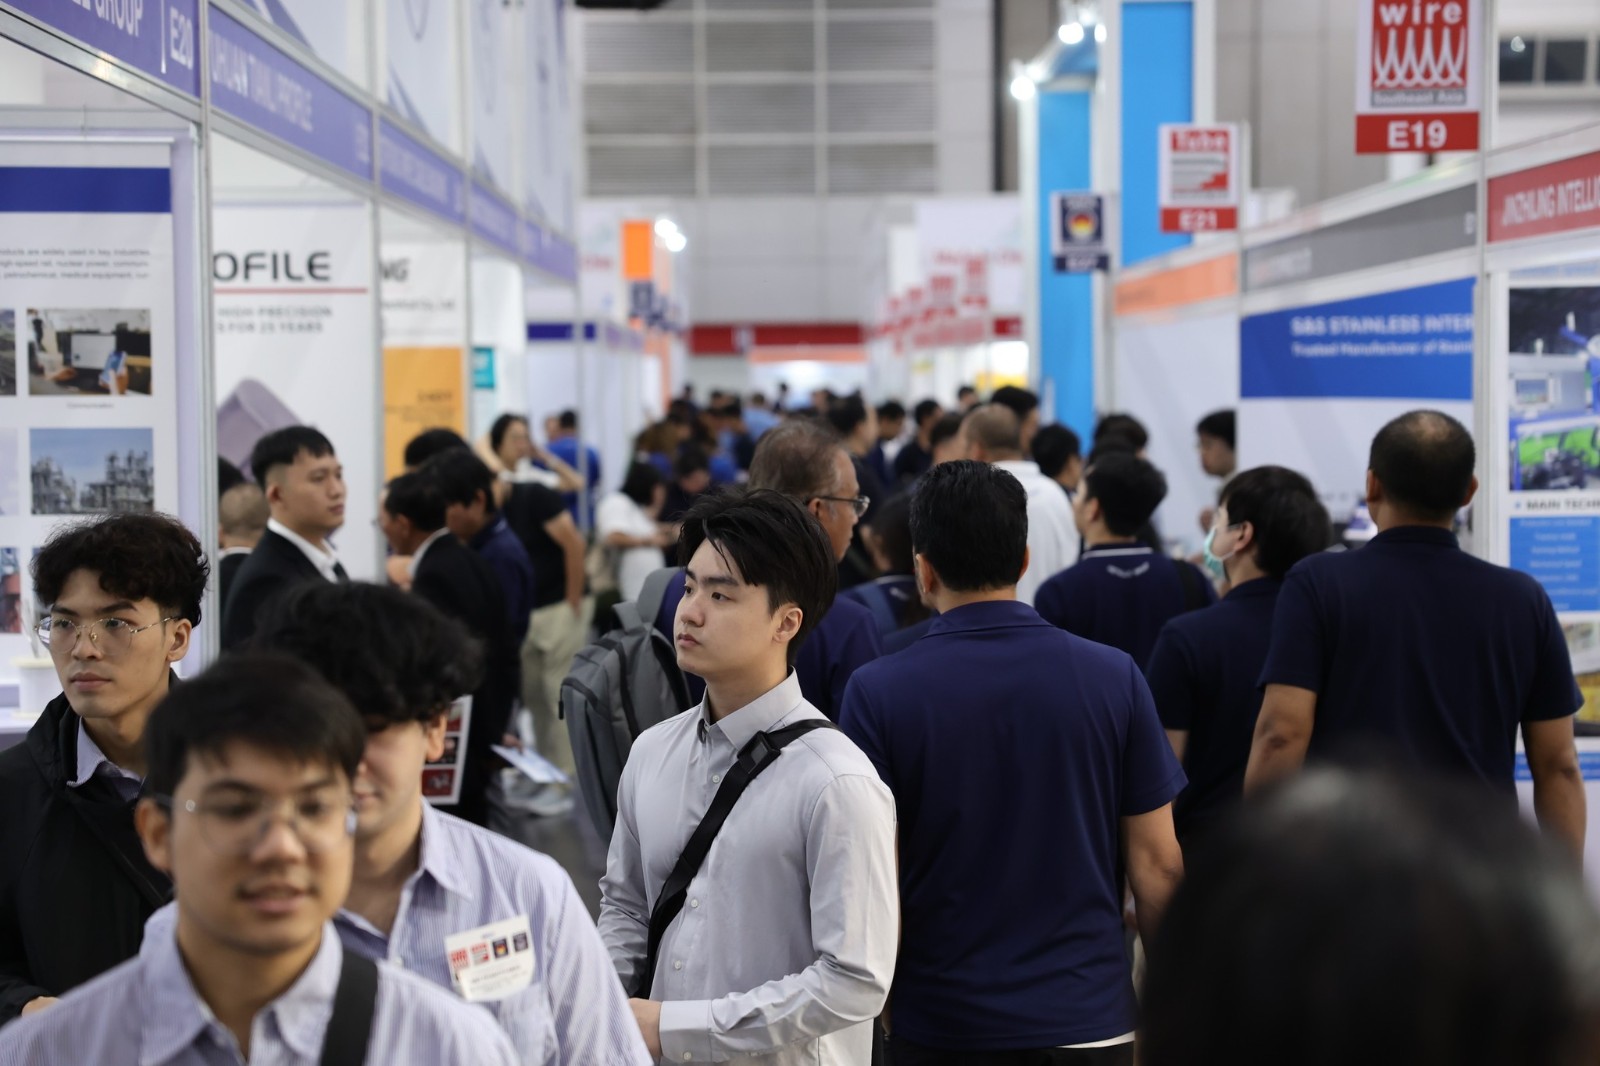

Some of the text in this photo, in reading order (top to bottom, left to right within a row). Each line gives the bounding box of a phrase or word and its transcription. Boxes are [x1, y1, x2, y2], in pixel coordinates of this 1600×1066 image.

[1379, 0, 1463, 25] wire
[170, 6, 194, 71] E20
[1387, 120, 1448, 149] E19
[1329, 315, 1421, 335] STAINLESS
[1526, 499, 1561, 511] MAIN
